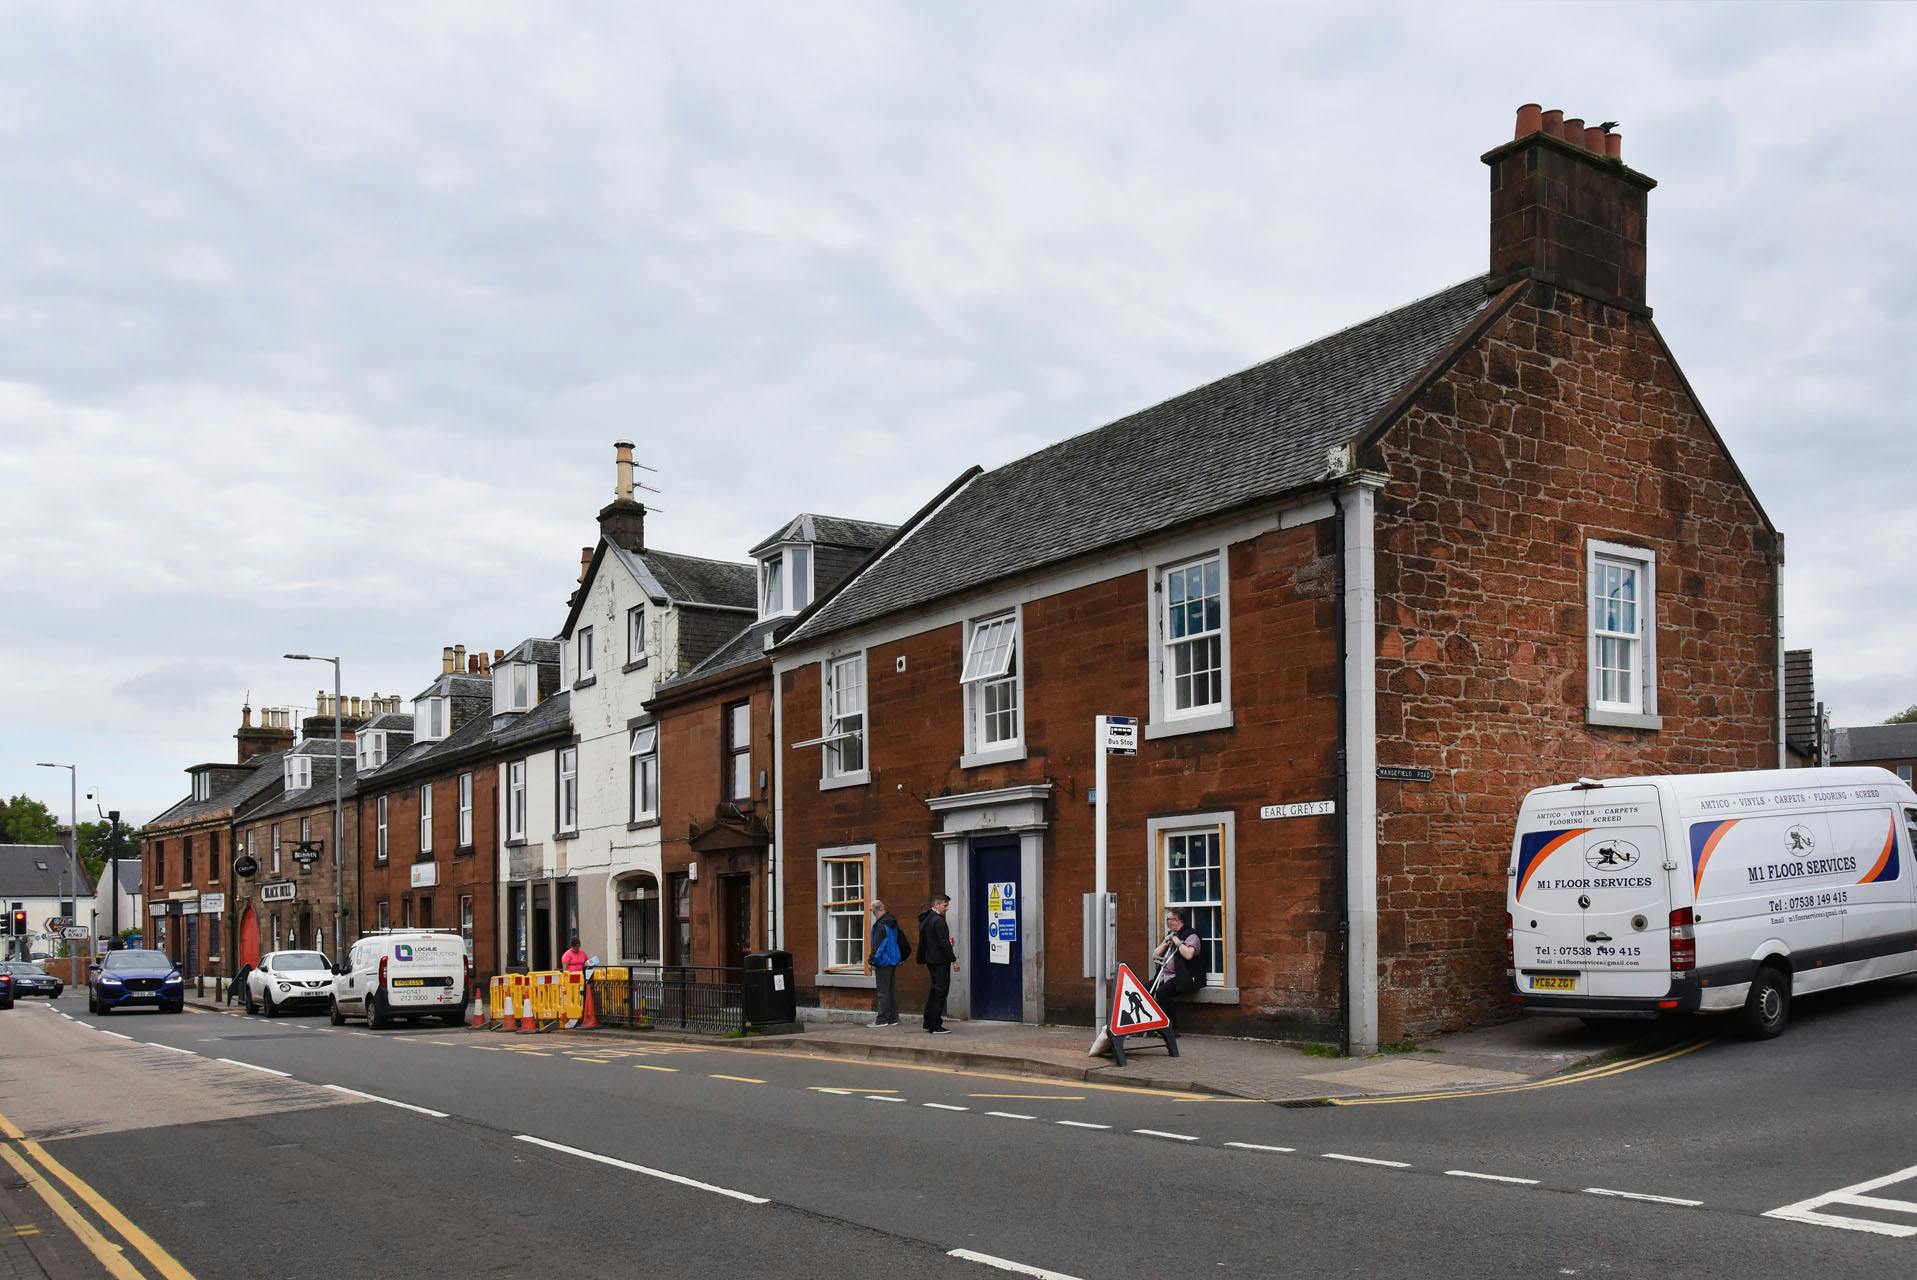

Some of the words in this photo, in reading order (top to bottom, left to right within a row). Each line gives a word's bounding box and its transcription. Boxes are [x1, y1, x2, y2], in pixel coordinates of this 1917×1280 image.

[1417, 771, 1430, 779] ROAD
[1700, 800, 1729, 810] AMTICO
[1738, 797, 1765, 807] VINYLS
[1774, 794, 1806, 805] CARPETS
[1814, 791, 1846, 802] FLOORING
[1855, 789, 1880, 799] SCREED
[1265, 804, 1287, 817] EARL
[1290, 802, 1314, 816] GREY
[1319, 802, 1330, 813] ST
[1537, 812, 1561, 820] AMTICO
[1550, 818, 1582, 826] FLOORING
[1748, 867, 1764, 882] M1
[1768, 862, 1804, 879] FLOOR
[1808, 856, 1856, 875] SERVICES
[1538, 880, 1551, 888] M1
[1555, 880, 1590, 888] FLOOR
[1594, 878, 1651, 887] SERVICES
[280, 885, 291, 897] BULL
[1769, 900, 1782, 911] Tel
[1790, 896, 1814, 909] 07538
[1817, 893, 1830, 905] 149
[1833, 892, 1847, 903] 415
[1536, 946, 1550, 955] Tel
[1559, 947, 1592, 955] 07538
[1597, 947, 1615, 956] 149
[1619, 947, 1640, 956] 415
[1535, 977, 1556, 988] YC62
[1558, 978, 1574, 988] ZGT
